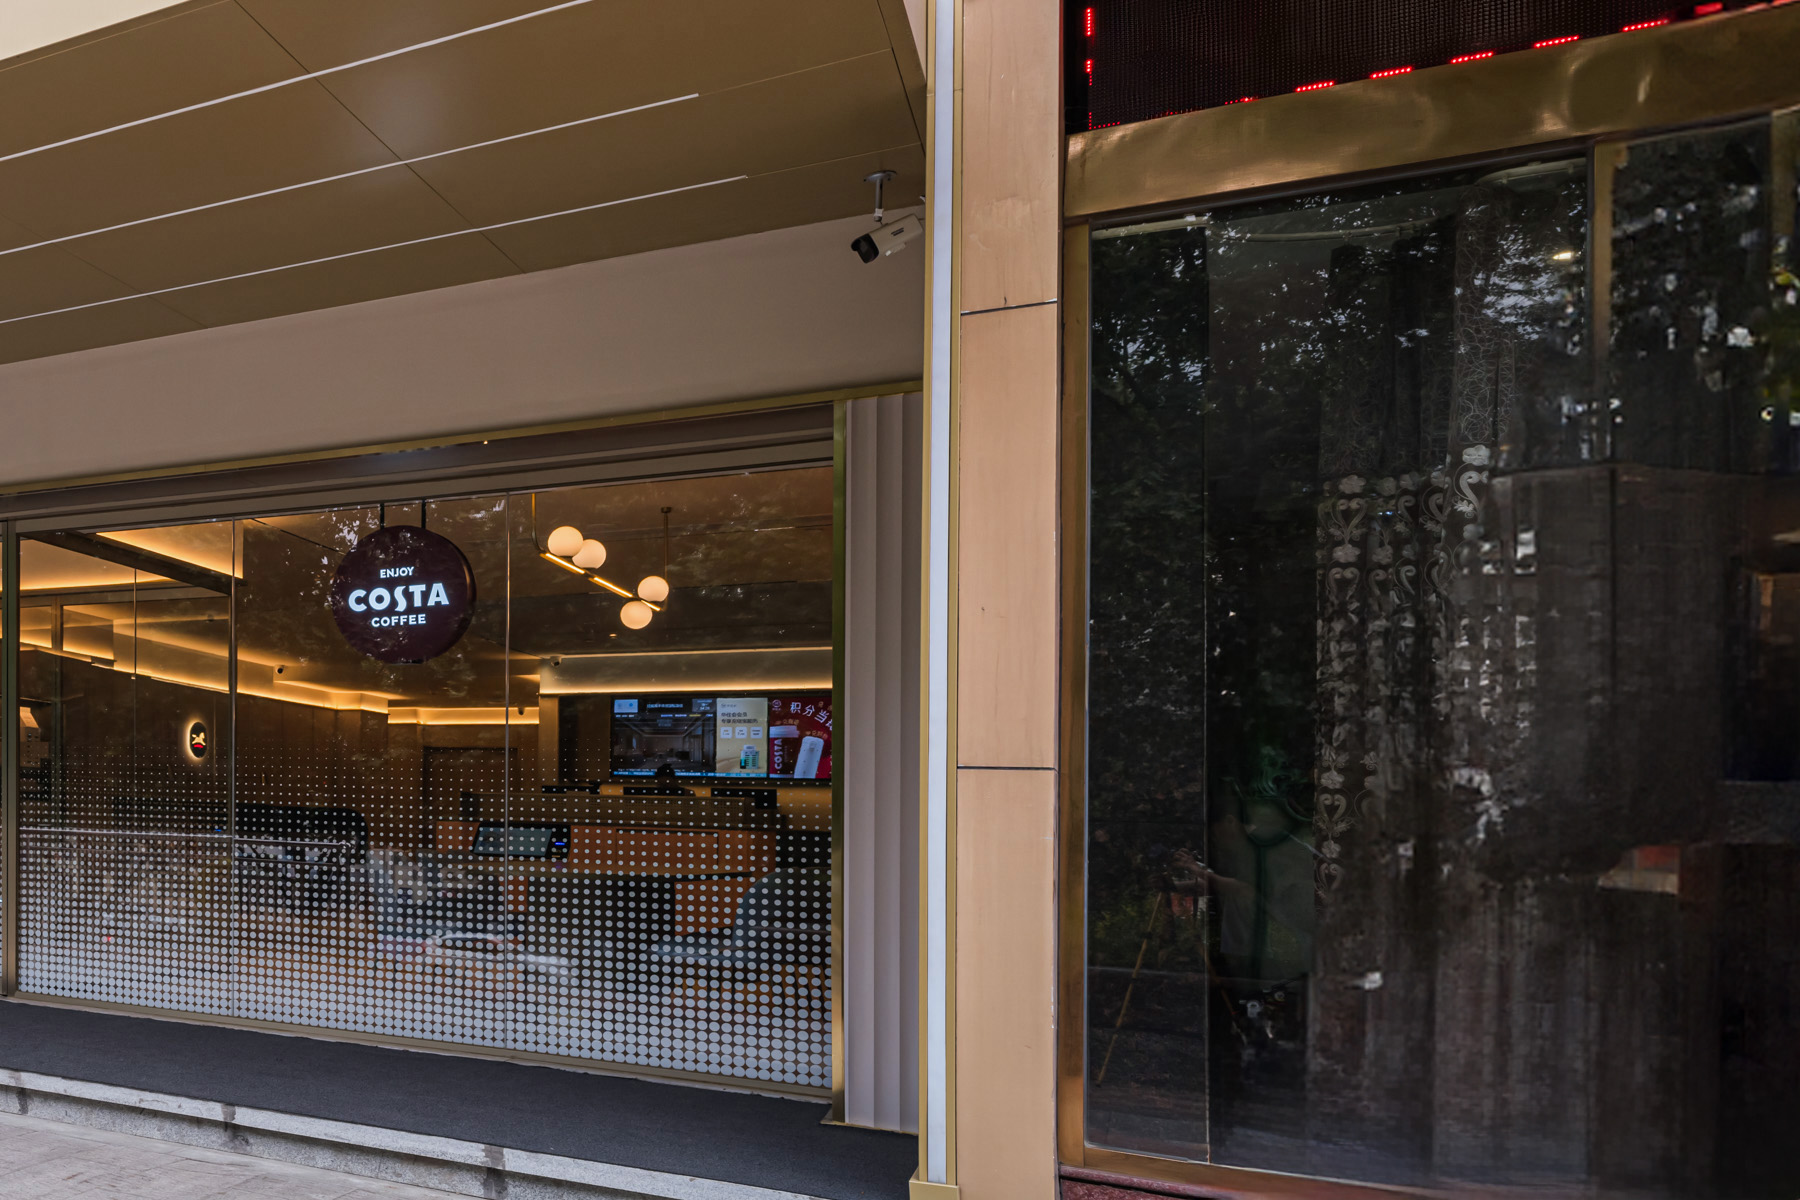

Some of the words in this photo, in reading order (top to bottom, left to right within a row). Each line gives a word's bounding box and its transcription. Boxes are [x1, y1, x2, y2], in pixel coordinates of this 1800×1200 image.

[380, 567, 414, 578] ENJOY
[348, 582, 450, 612] COSTA
[371, 614, 426, 627] COFFEE
[774, 738, 783, 769] COSTA
